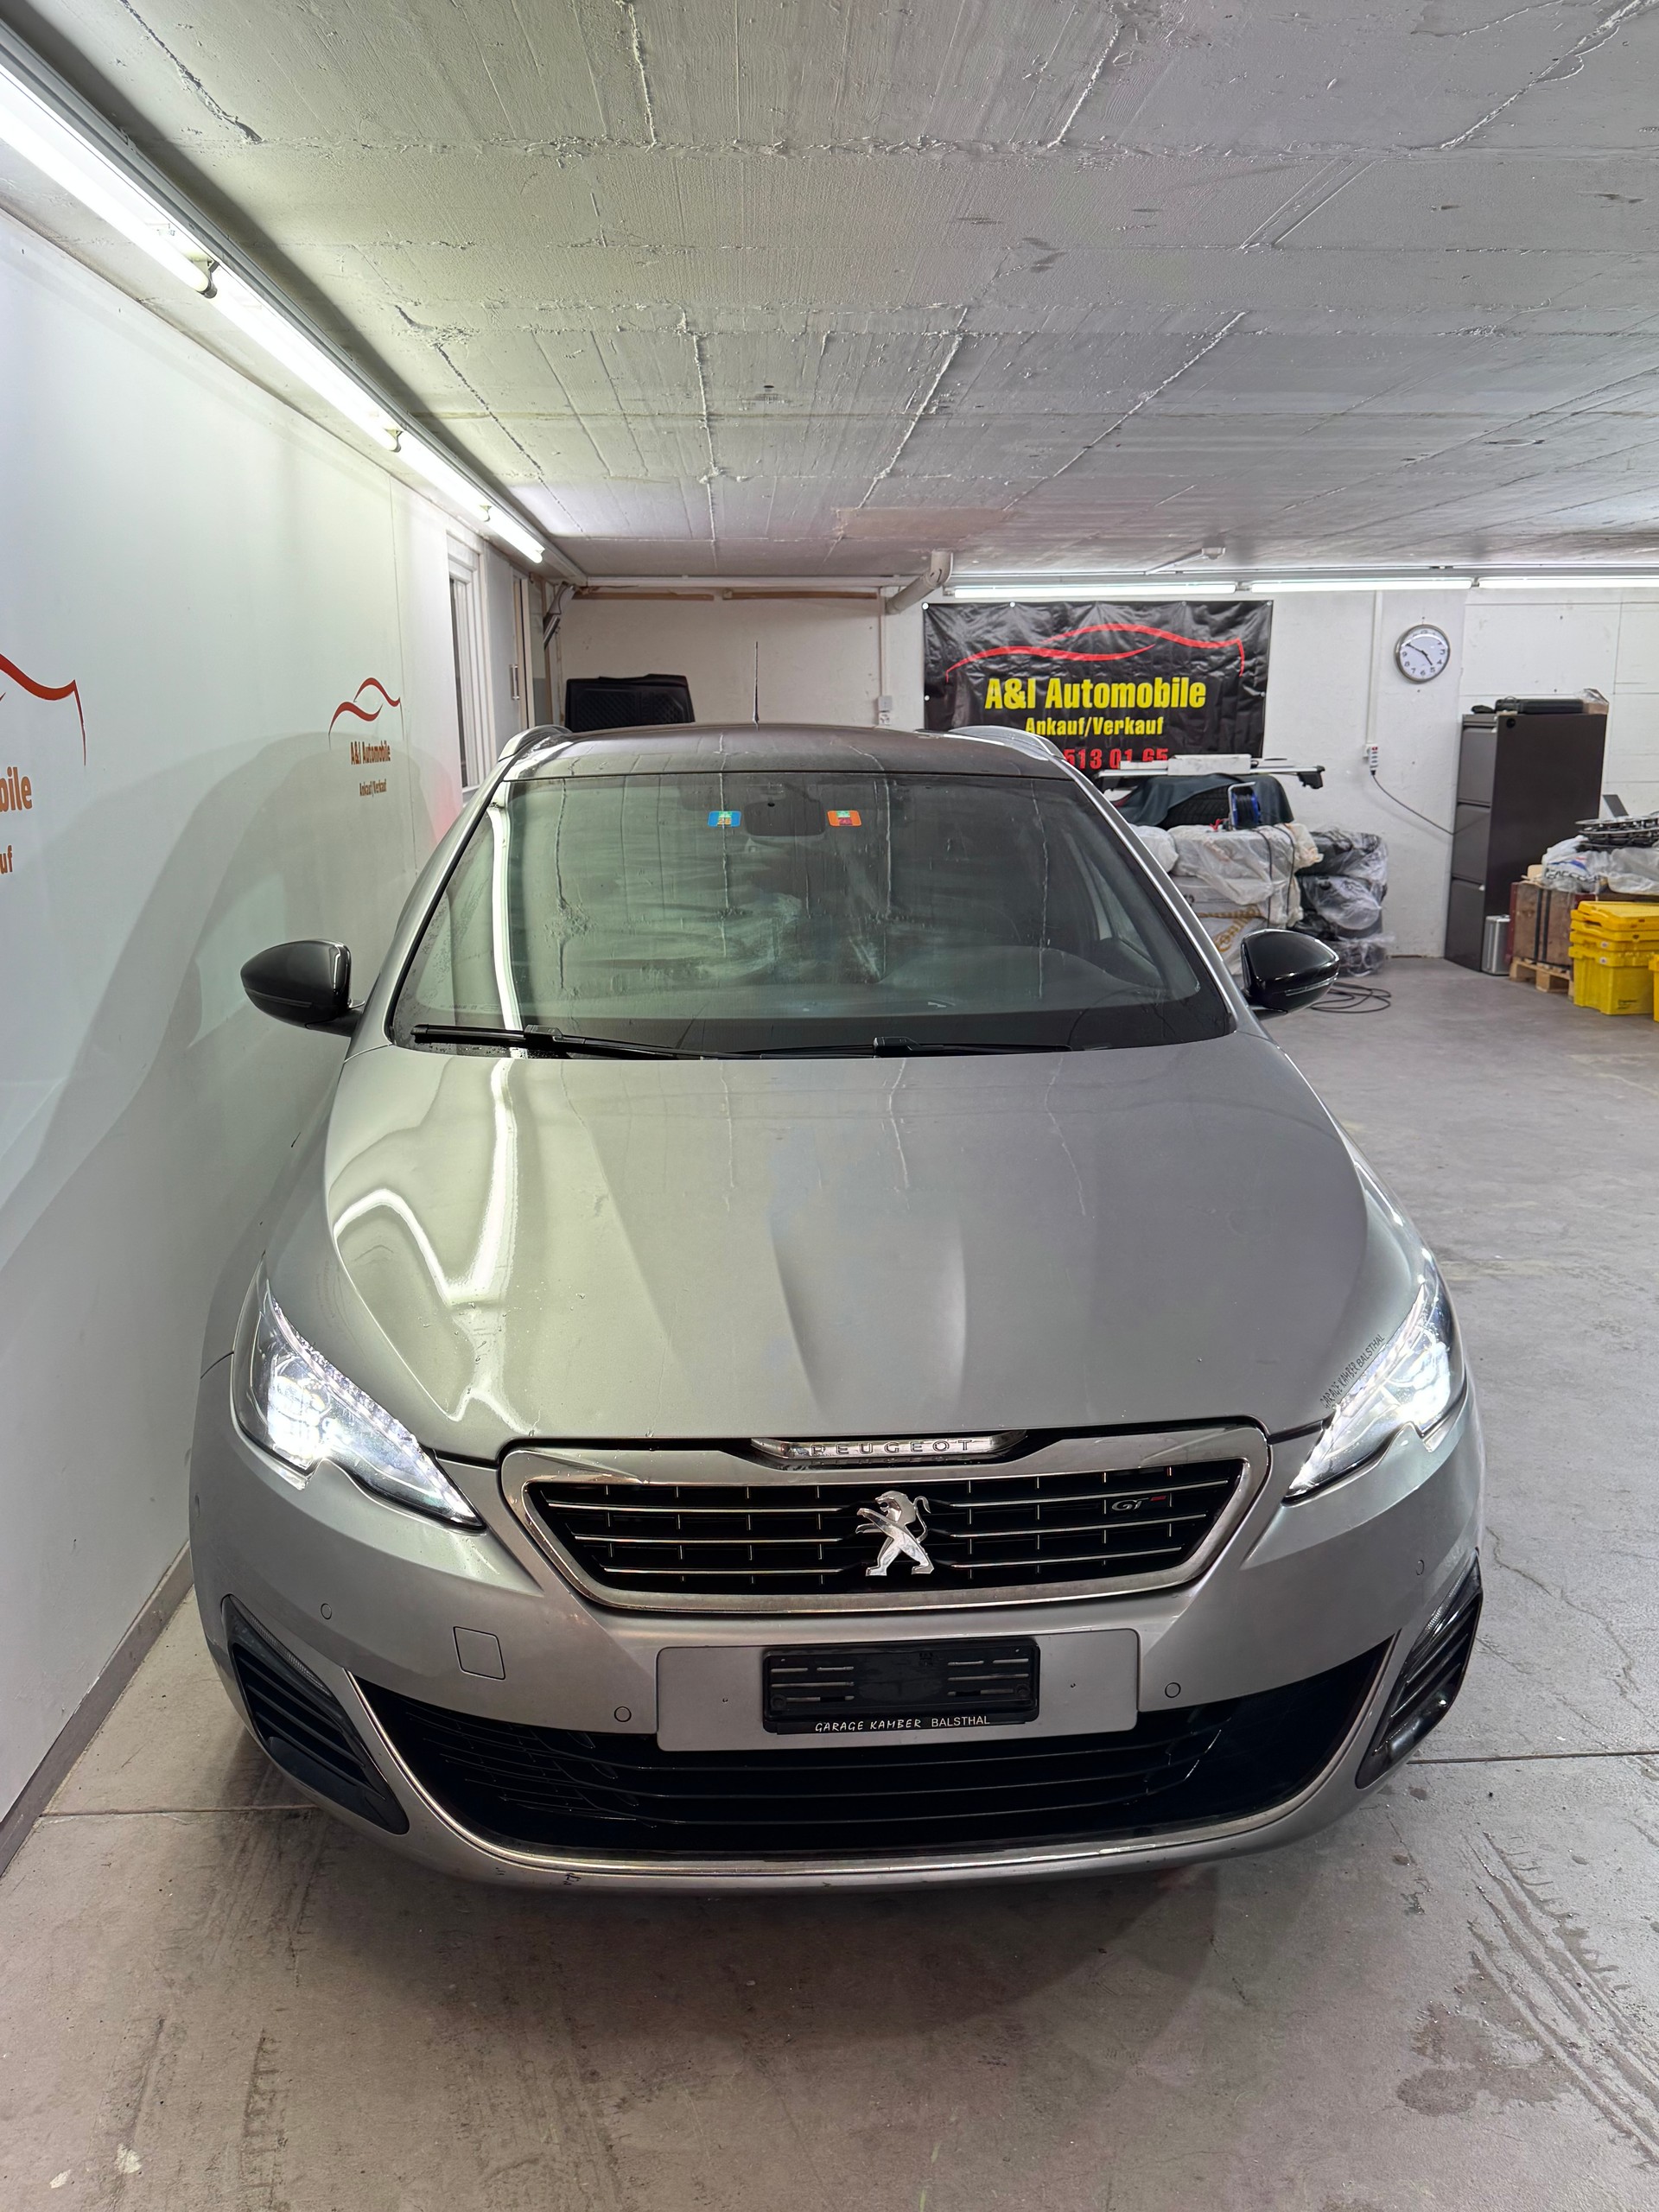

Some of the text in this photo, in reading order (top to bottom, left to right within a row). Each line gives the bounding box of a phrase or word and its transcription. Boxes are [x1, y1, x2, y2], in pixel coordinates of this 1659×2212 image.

[984, 677, 1206, 709] A&I Automobile
[1026, 716, 1164, 737] Ankauf/Verkauf
[362, 740, 391, 764] Automobile
[1319, 1334, 1385, 1409] GARAGE KAMBER BALSTHAL
[810, 1439, 973, 1457] PEUGEOT
[1111, 1497, 1149, 1511] GT
[815, 1715, 990, 1732] GARAGE KAMBER BALSTHAL
